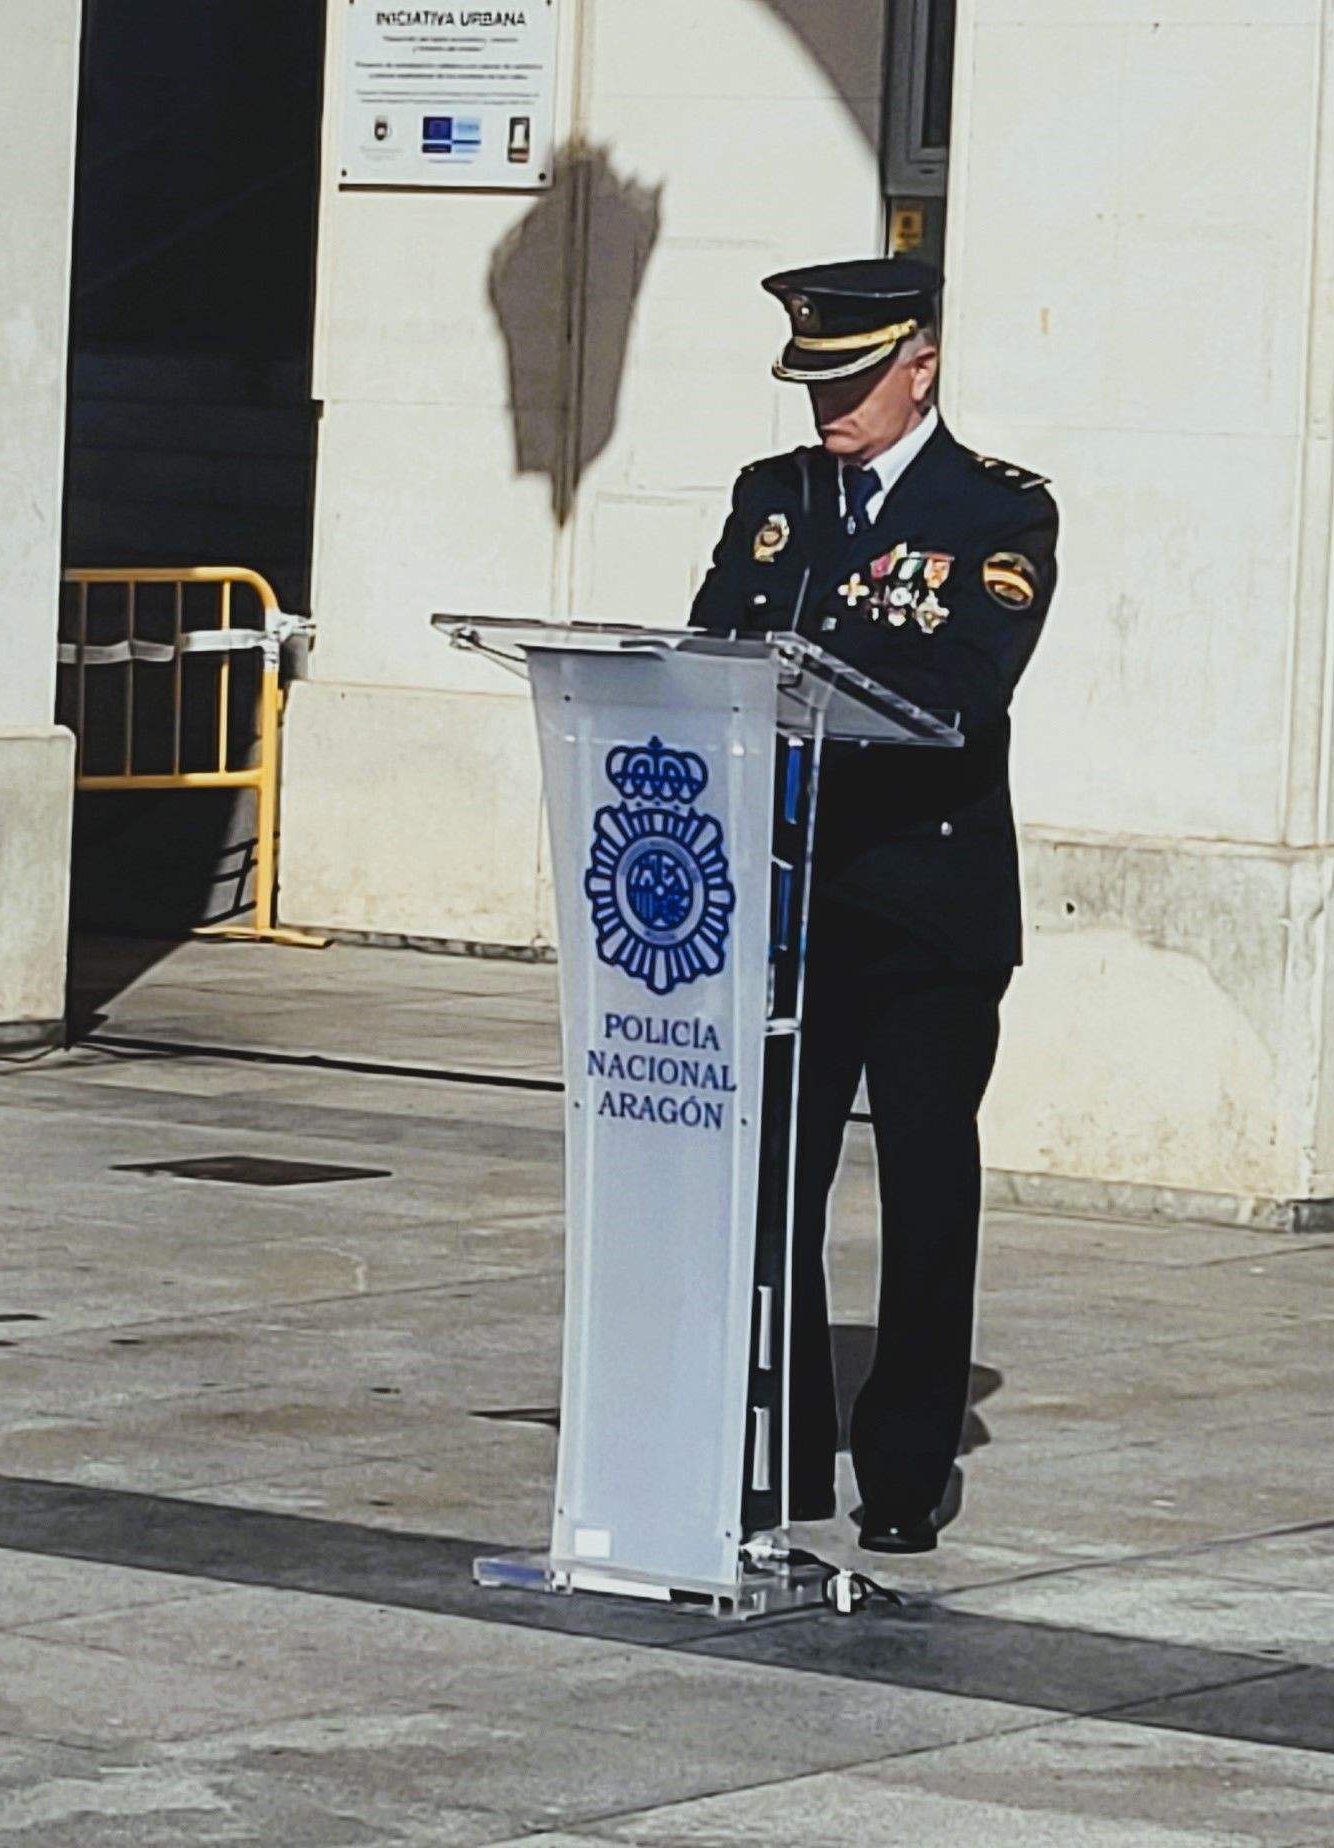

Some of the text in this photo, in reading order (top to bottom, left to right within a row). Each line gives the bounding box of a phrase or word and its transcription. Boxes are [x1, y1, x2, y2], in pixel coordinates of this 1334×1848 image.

[376, 10, 526, 27] INICIATIVA URBANA
[605, 1013, 720, 1050] POLICÍA
[587, 1050, 737, 1092] NACIONAL
[598, 1091, 724, 1129] ARAGÓN
